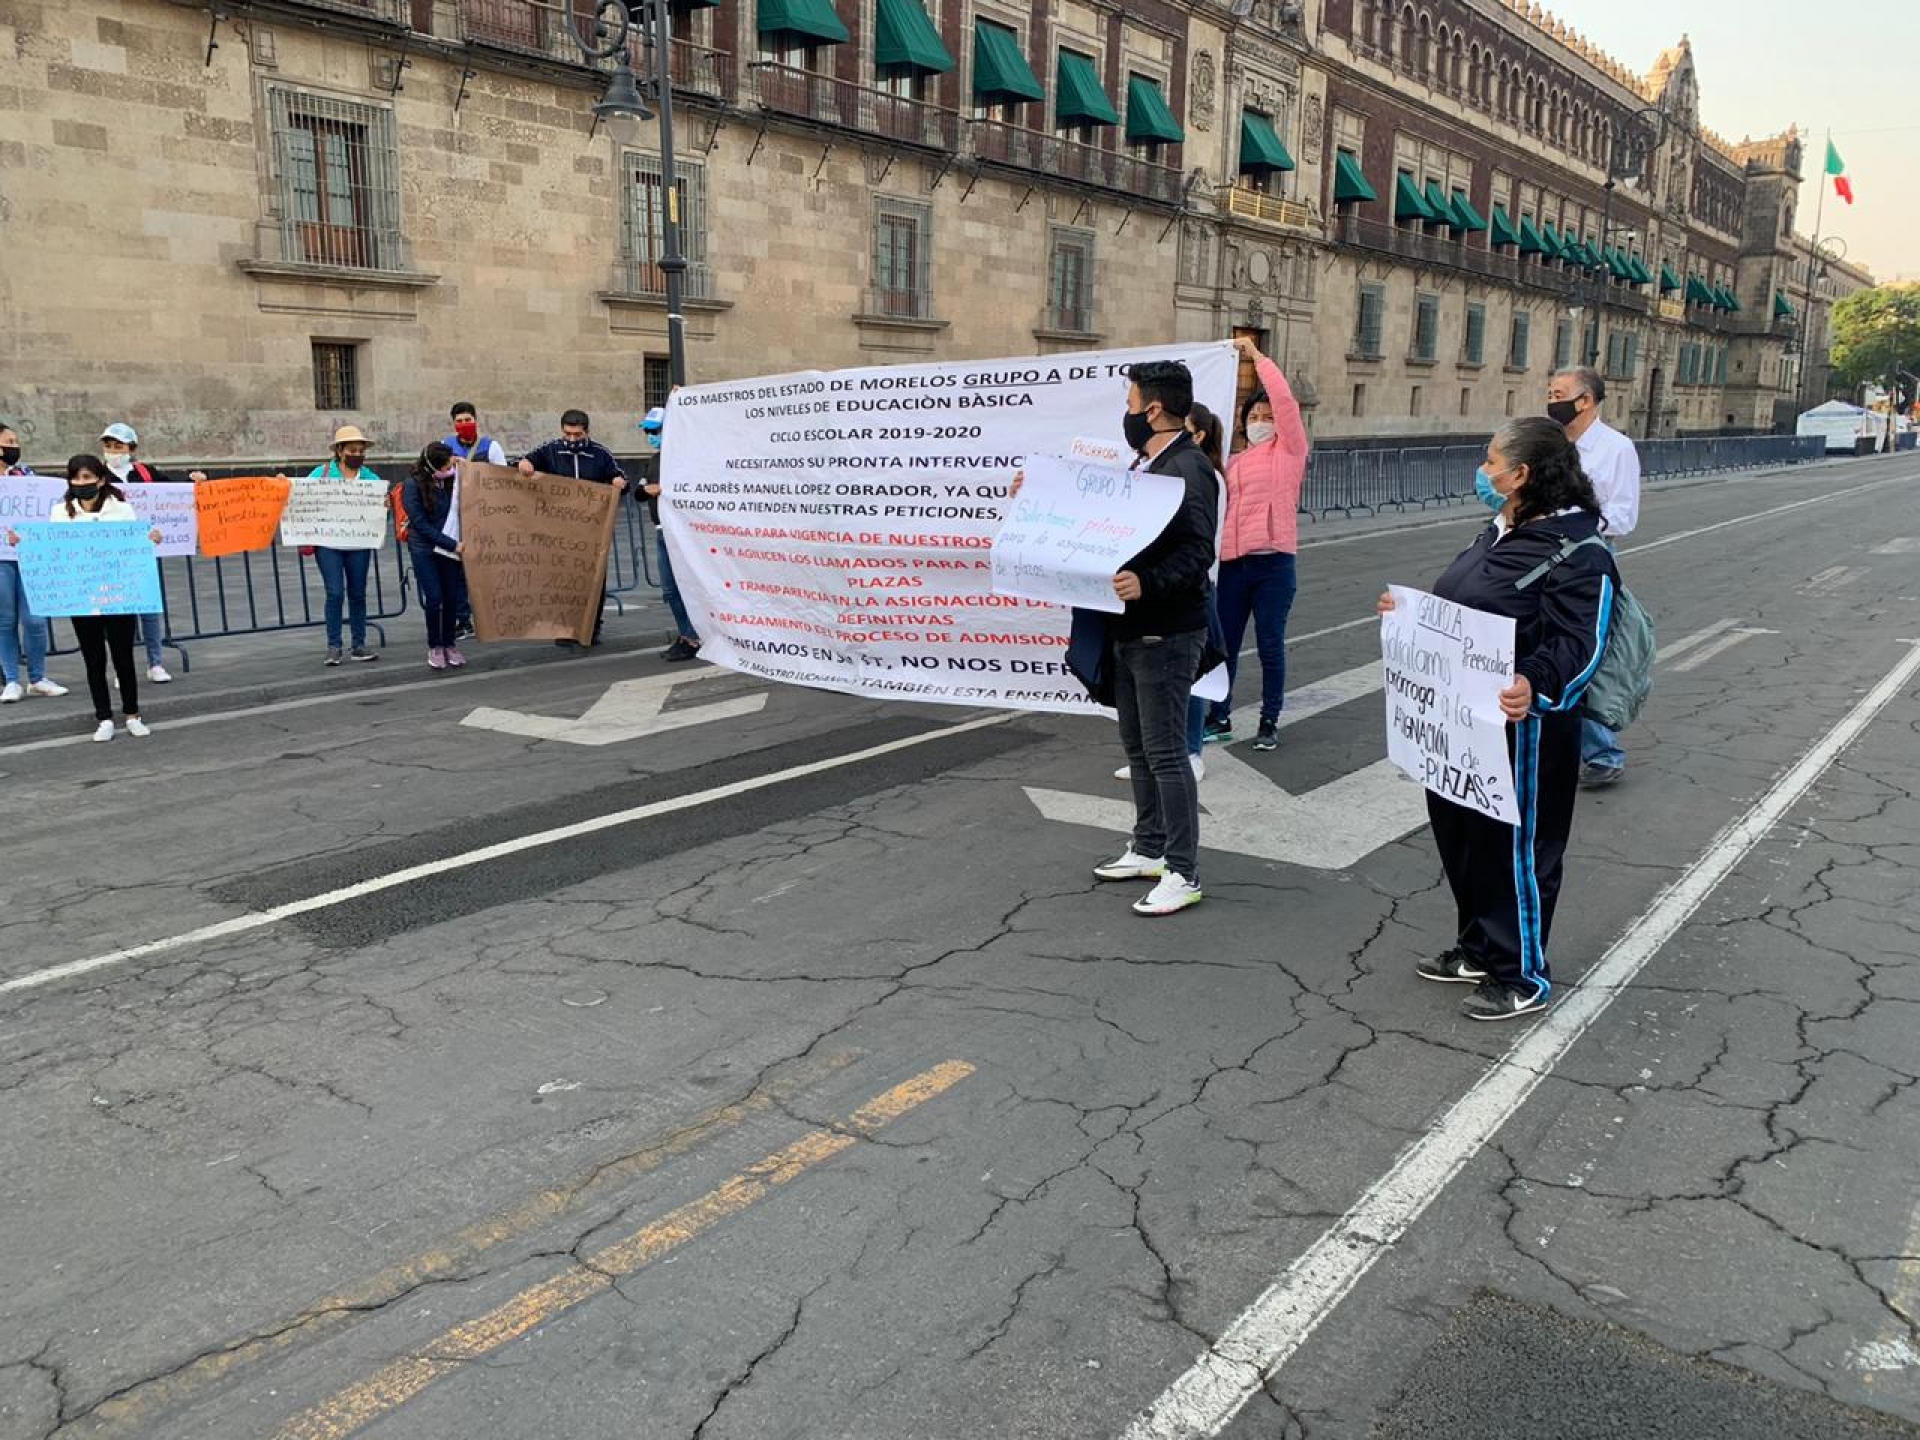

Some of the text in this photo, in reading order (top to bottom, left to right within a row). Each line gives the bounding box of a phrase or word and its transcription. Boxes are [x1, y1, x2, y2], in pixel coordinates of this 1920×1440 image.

[678, 395, 698, 407] LOS
[700, 390, 755, 405] MAESTROS
[758, 386, 778, 400] DEL
[780, 381, 825, 398] ESTADO
[830, 379, 851, 392] DE
[860, 374, 958, 390] MORELOS
[963, 369, 1040, 387] GRUPO
[1045, 368, 1063, 383] A
[1069, 366, 1099, 380] DE
[745, 406, 765, 419] LOS
[768, 404, 811, 418] NIVELES
[813, 401, 831, 414] DE
[770, 426, 982, 443] CICLO ESCOLAR 2019-2020
[725, 455, 1028, 470] NECESITAMOS SU PRONTA INTERVENC
[673, 482, 693, 494] LIC.
[743, 482, 792, 495] MANUEL
[795, 483, 832, 496] LOPEZ
[835, 484, 938, 499] OBRADOR,
[944, 484, 970, 499] YA
[976, 485, 1009, 499] QU
[717, 500, 736, 513] NO
[738, 501, 797, 515] ATIENDEN
[800, 503, 878, 517] NUESTRAS
[883, 505, 1004, 521] PETICIONES,
[506, 531, 526, 547] EL
[755, 527, 787, 538] PARA
[790, 530, 854, 543] VIGENCIA
[859, 532, 883, 545] DE
[888, 533, 994, 548] NUESTROS
[789, 552, 812, 565] LOS
[813, 555, 907, 569] LLAMADOS
[912, 558, 969, 570] PARA
[847, 576, 923, 588] PLAZAS
[855, 595, 879, 607] LA
[719, 612, 812, 633] APLAZAMIENTO
[836, 630, 919, 643] PROCESO
[926, 631, 954, 643] DE
[837, 613, 954, 625] DEFINITIVAS
[725, 635, 808, 658] ONFIAMOS
[812, 648, 832, 661] EN
[901, 656, 940, 670] NO
[947, 657, 1002, 673] NOS
[953, 685, 997, 699] ESTA
[1005, 688, 1096, 704] ENSEÑAN
[1425, 757, 1490, 809] PLAZAS
